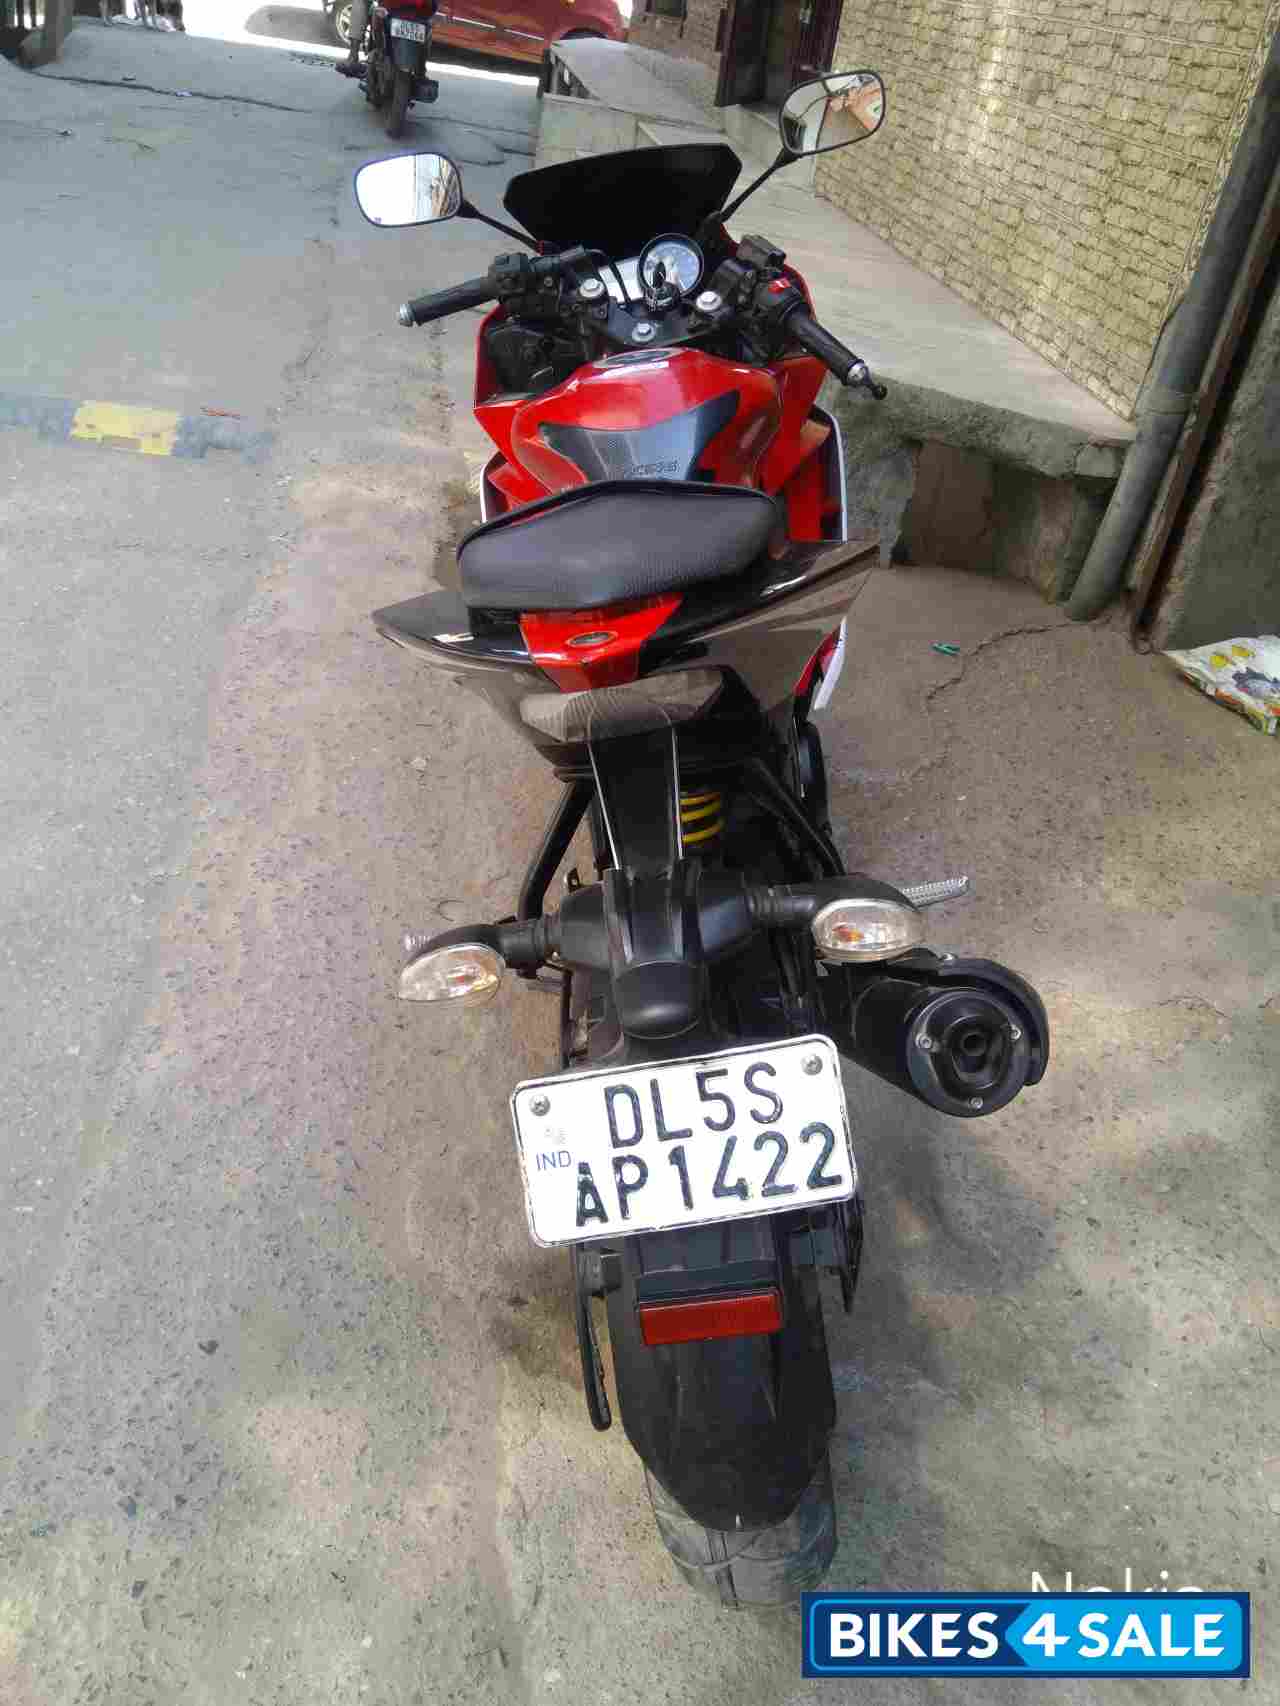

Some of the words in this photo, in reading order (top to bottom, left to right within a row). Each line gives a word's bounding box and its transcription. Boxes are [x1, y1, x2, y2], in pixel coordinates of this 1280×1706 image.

[603, 1062, 784, 1150] DL5S
[535, 1150, 572, 1171] IND
[575, 1121, 843, 1228] AP1422
